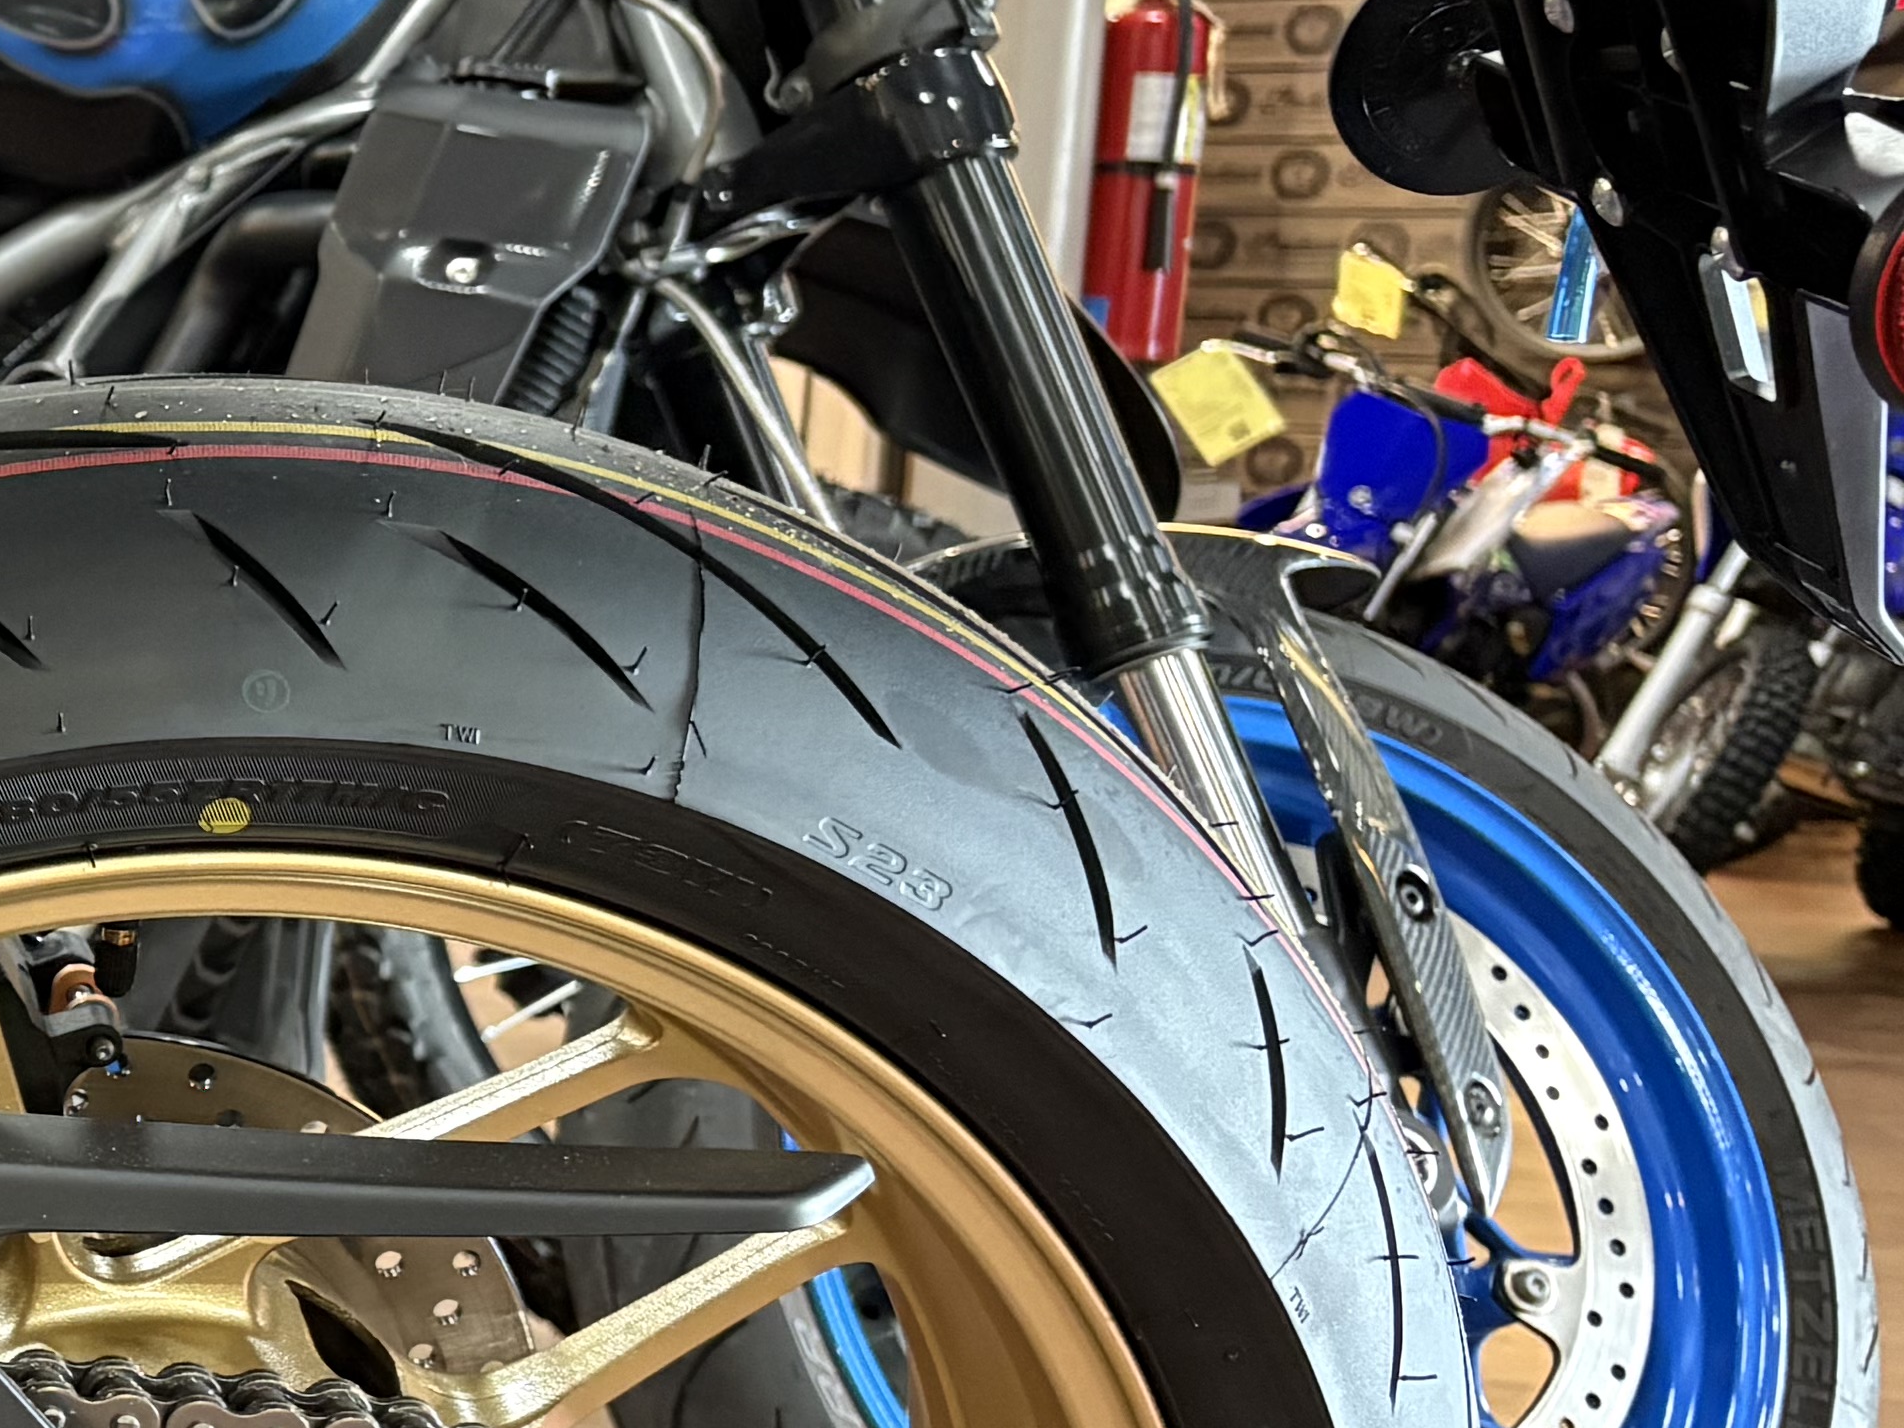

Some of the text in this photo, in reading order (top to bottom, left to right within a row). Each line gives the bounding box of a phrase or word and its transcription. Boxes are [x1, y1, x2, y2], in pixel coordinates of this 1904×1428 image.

[439, 722, 482, 745] TWI
[801, 816, 954, 912] S23
[1289, 1285, 1311, 1324] TWI
